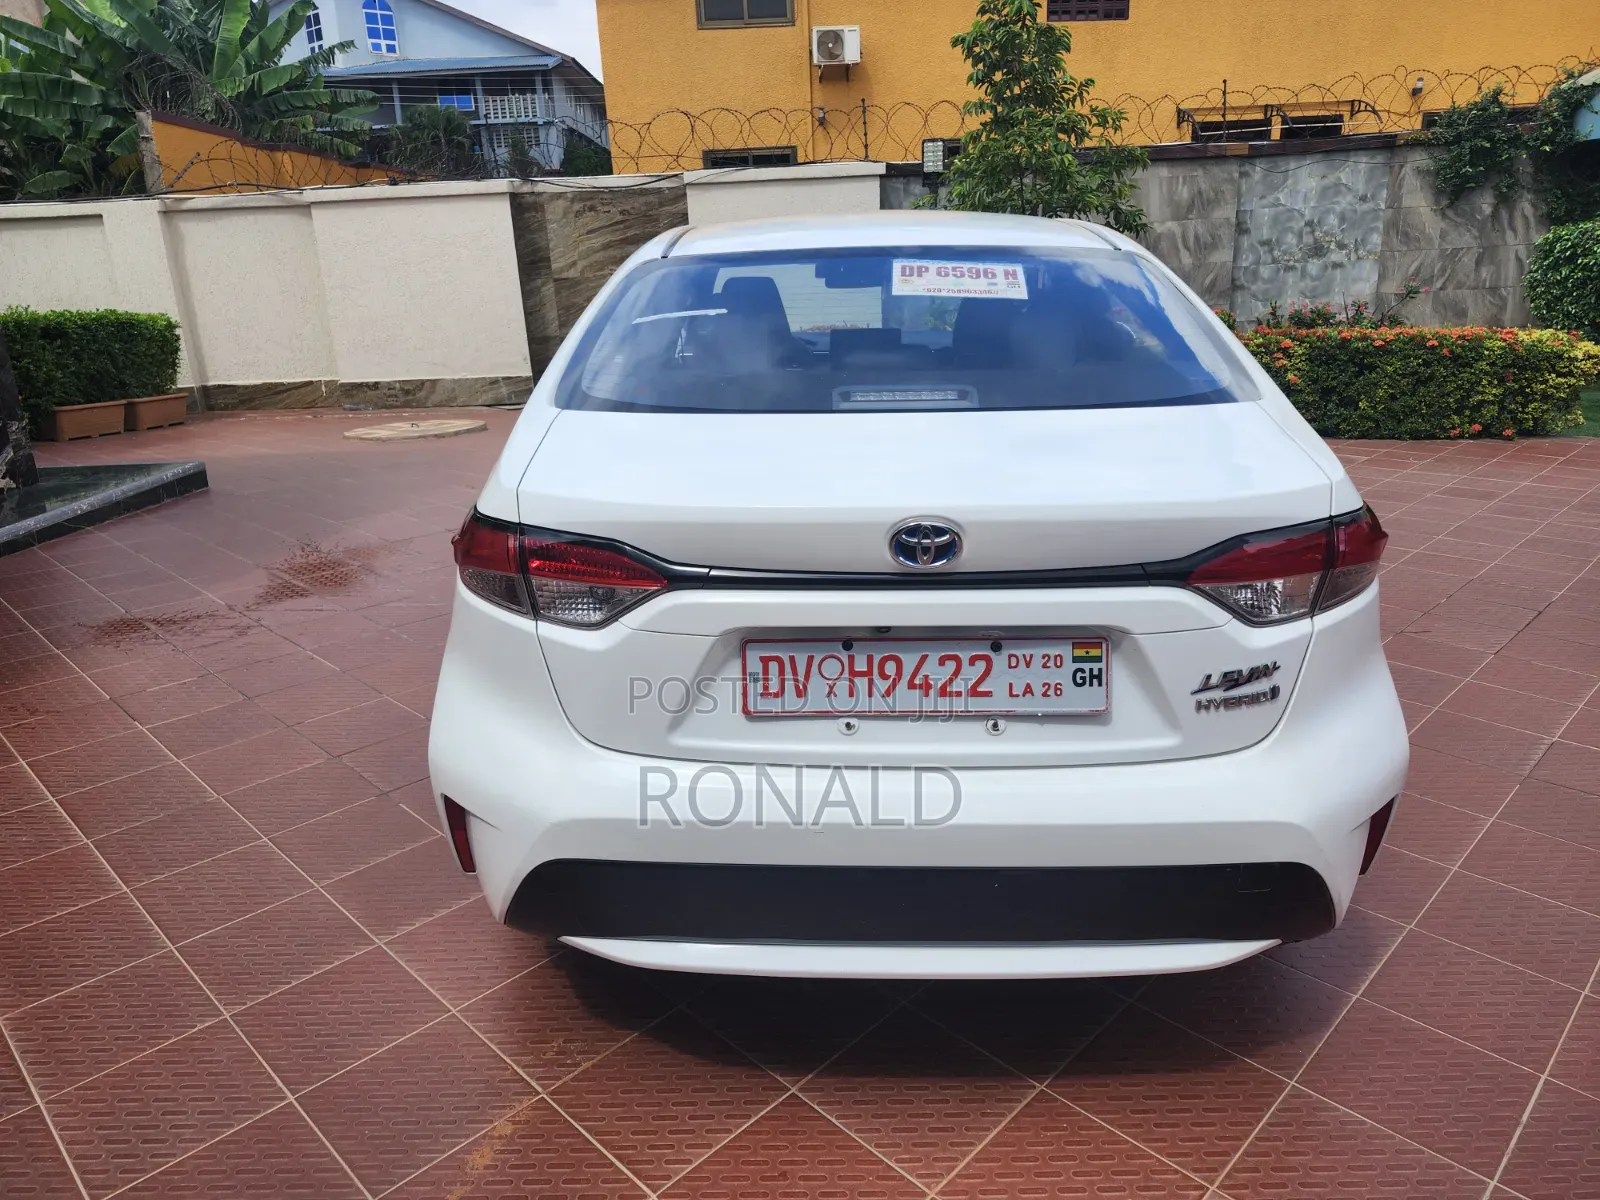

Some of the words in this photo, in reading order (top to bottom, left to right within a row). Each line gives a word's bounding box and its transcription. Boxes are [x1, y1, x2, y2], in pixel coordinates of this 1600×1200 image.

[900, 264, 930, 278] DP
[935, 265, 998, 280] 6596
[1003, 268, 1019, 281] N
[1007, 653, 1034, 669] DV
[1041, 653, 1064, 669] 20
[1071, 667, 1103, 688] GH
[1008, 682, 1035, 698] LA
[1041, 682, 1063, 698] 26
[1195, 688, 1270, 713] HYBRID
